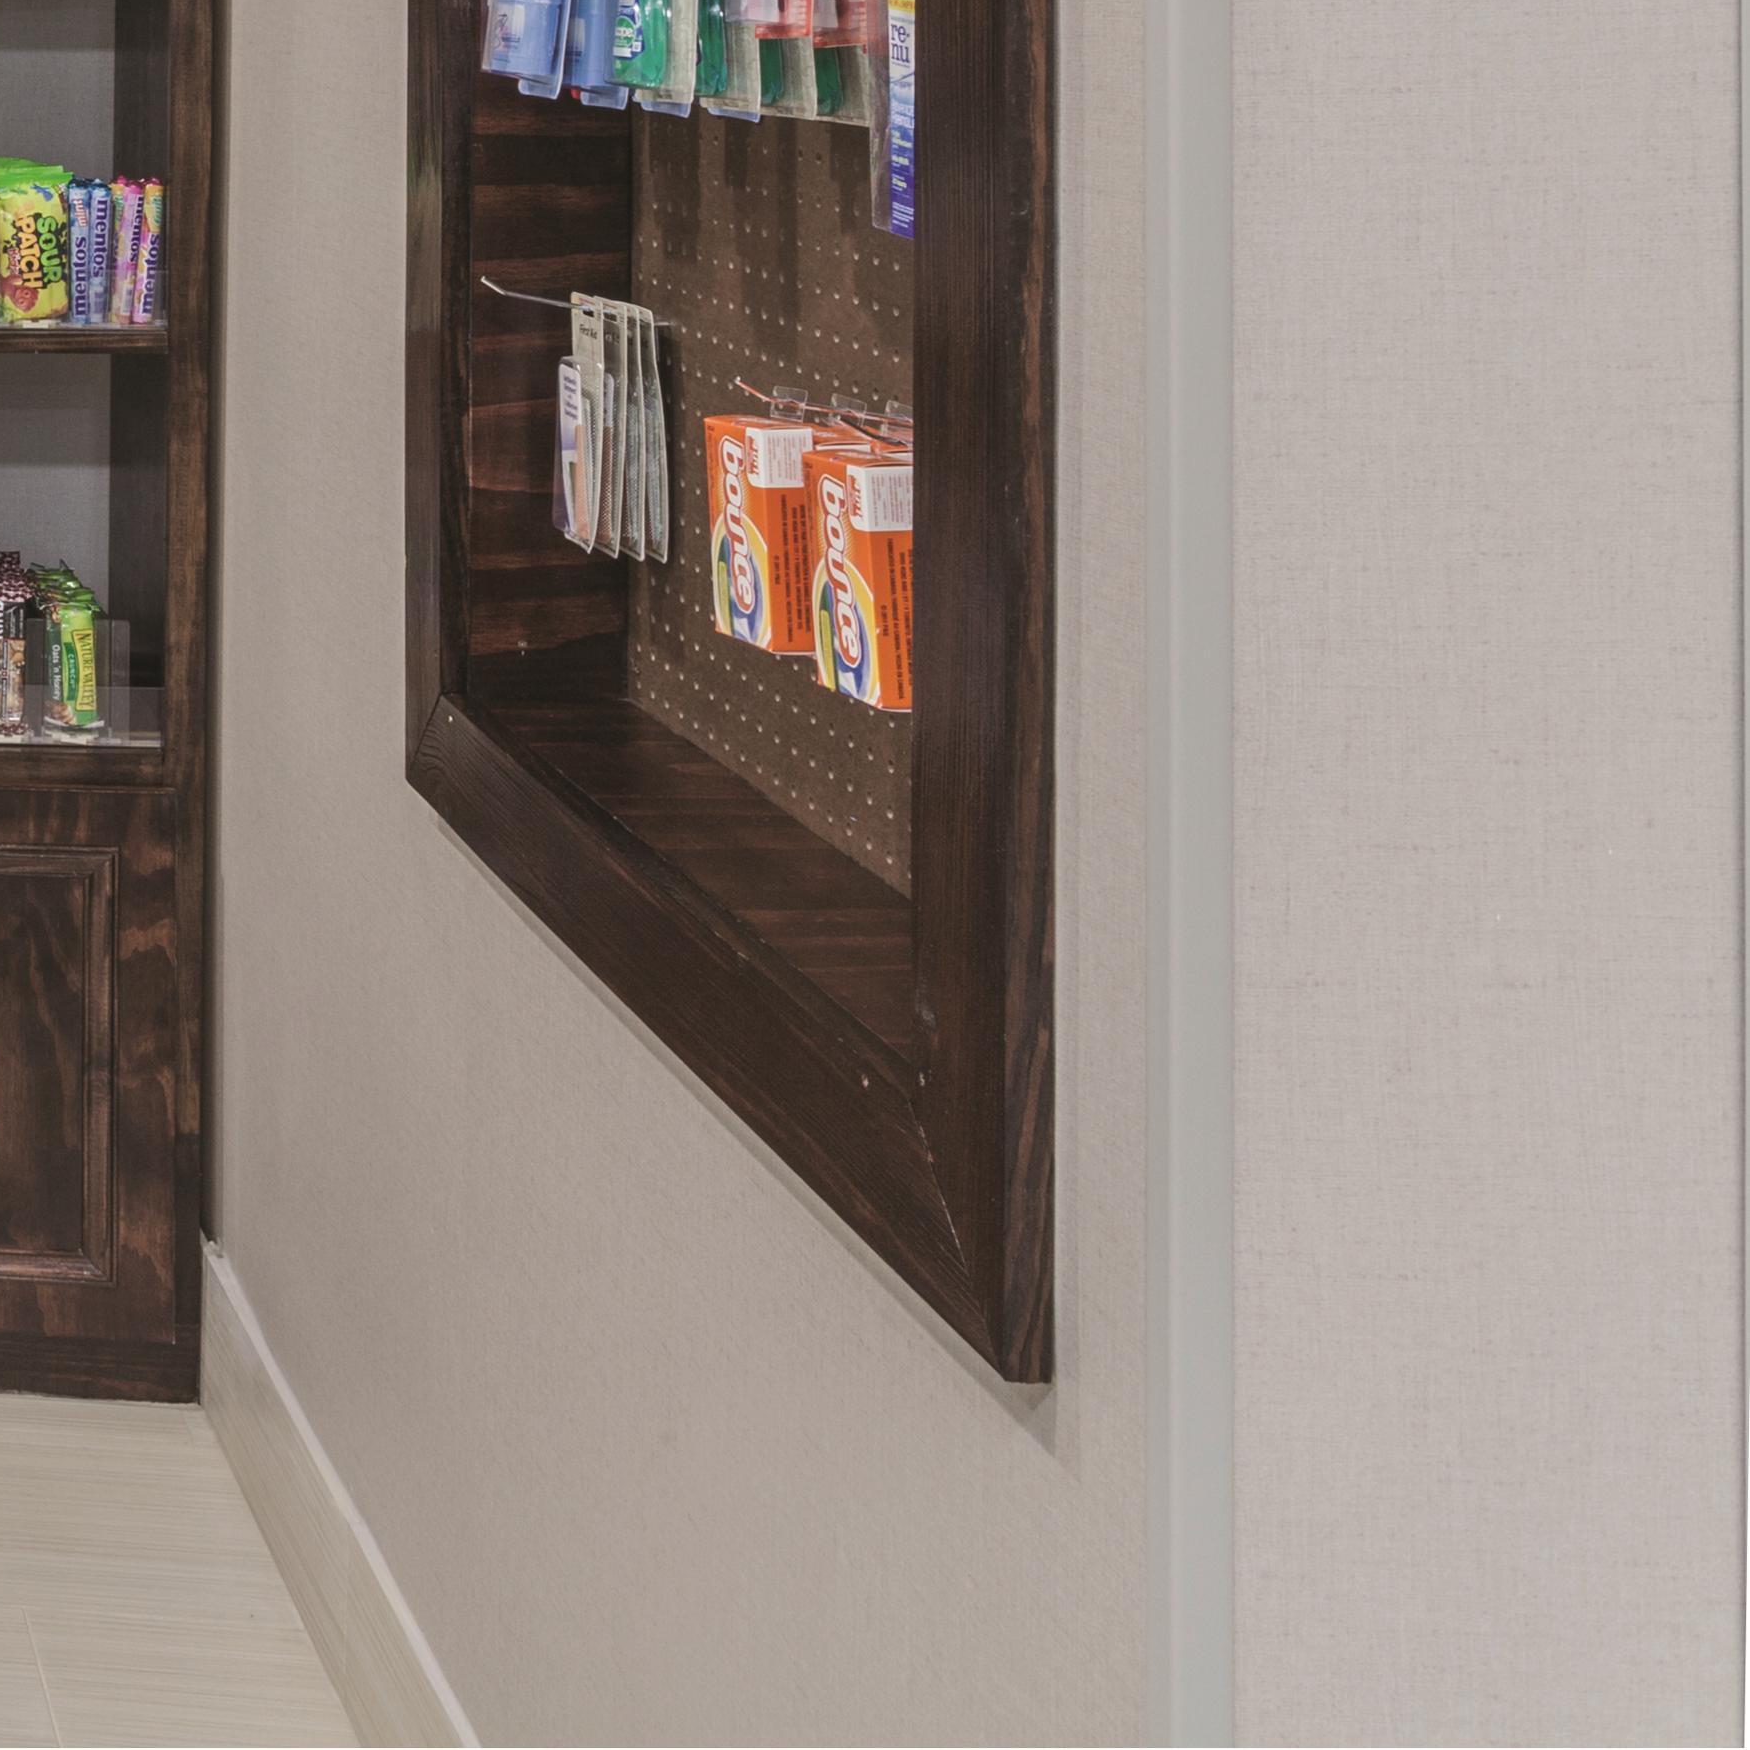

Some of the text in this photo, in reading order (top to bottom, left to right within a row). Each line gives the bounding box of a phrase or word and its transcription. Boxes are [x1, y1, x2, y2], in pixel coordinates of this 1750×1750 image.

[890, 44, 910, 64] nu
[15, 215, 44, 289] PATCH
[36, 215, 62, 284] SOUR
[92, 199, 108, 278] mentos
[130, 195, 145, 263] mentos
[73, 236, 88, 317] mentos
[142, 233, 159, 315] mentos
[719, 435, 756, 613] bounce
[819, 473, 862, 668] bounce
[51, 644, 62, 701] Oats Honey
[79, 632, 97, 710] NATURE VALLEY
